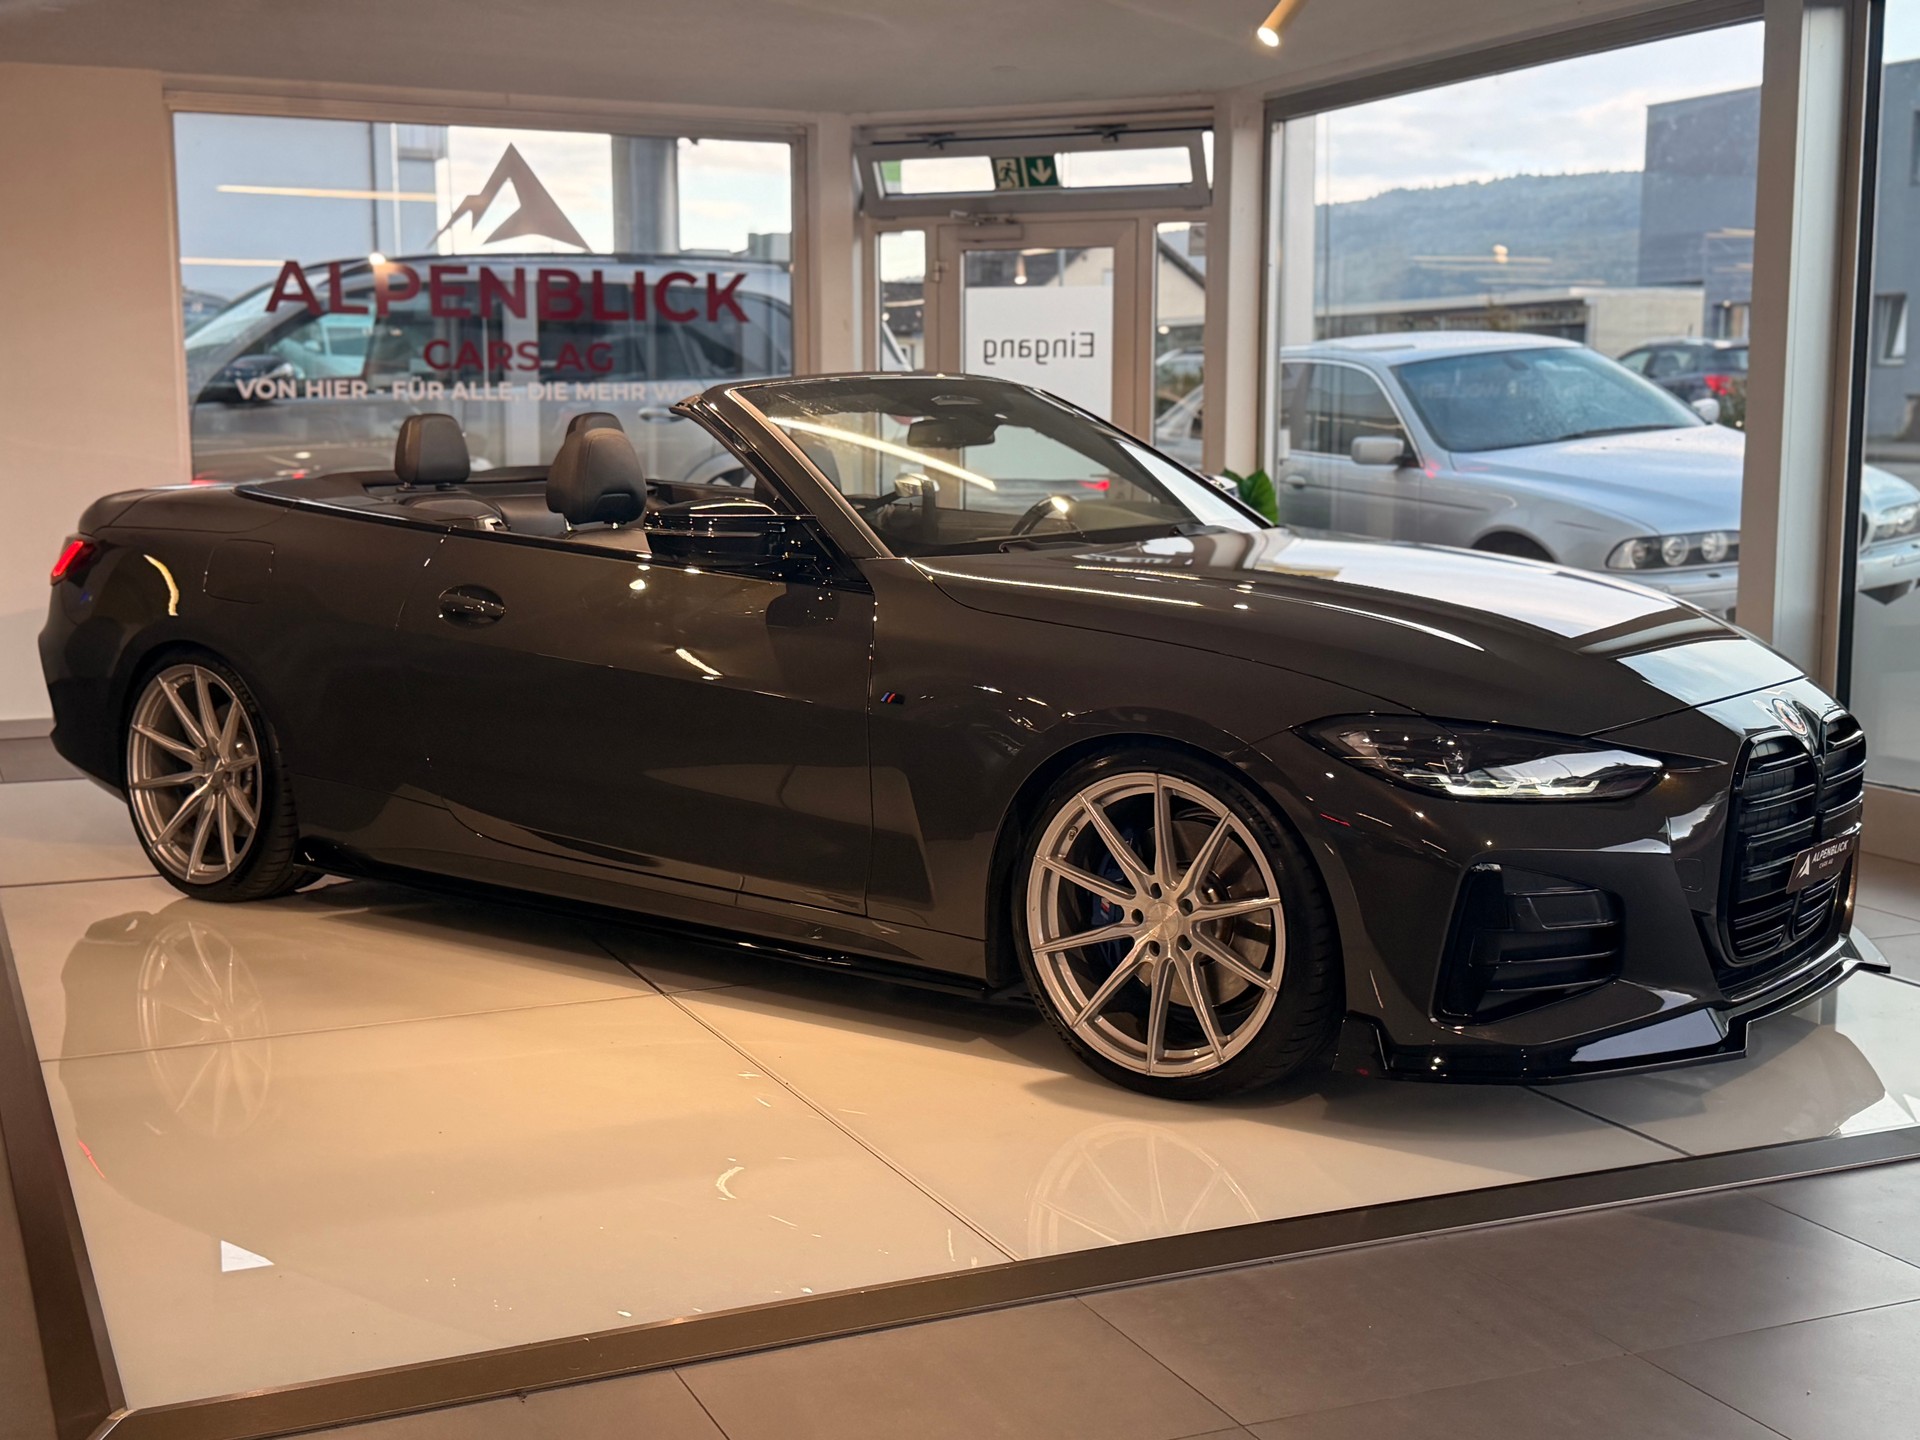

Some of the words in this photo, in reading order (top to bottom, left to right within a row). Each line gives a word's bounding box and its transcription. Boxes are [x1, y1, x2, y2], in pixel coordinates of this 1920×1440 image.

[264, 260, 750, 323] ALPENBLICK
[424, 339, 541, 372] CARS
[555, 341, 614, 373] AG
[235, 379, 298, 400] VON
[305, 380, 368, 400] HIER
[392, 376, 445, 401] FÜR
[527, 382, 570, 401] DIE
[575, 382, 647, 401] MEHR
[1811, 839, 1850, 864] ALPENBLICK
